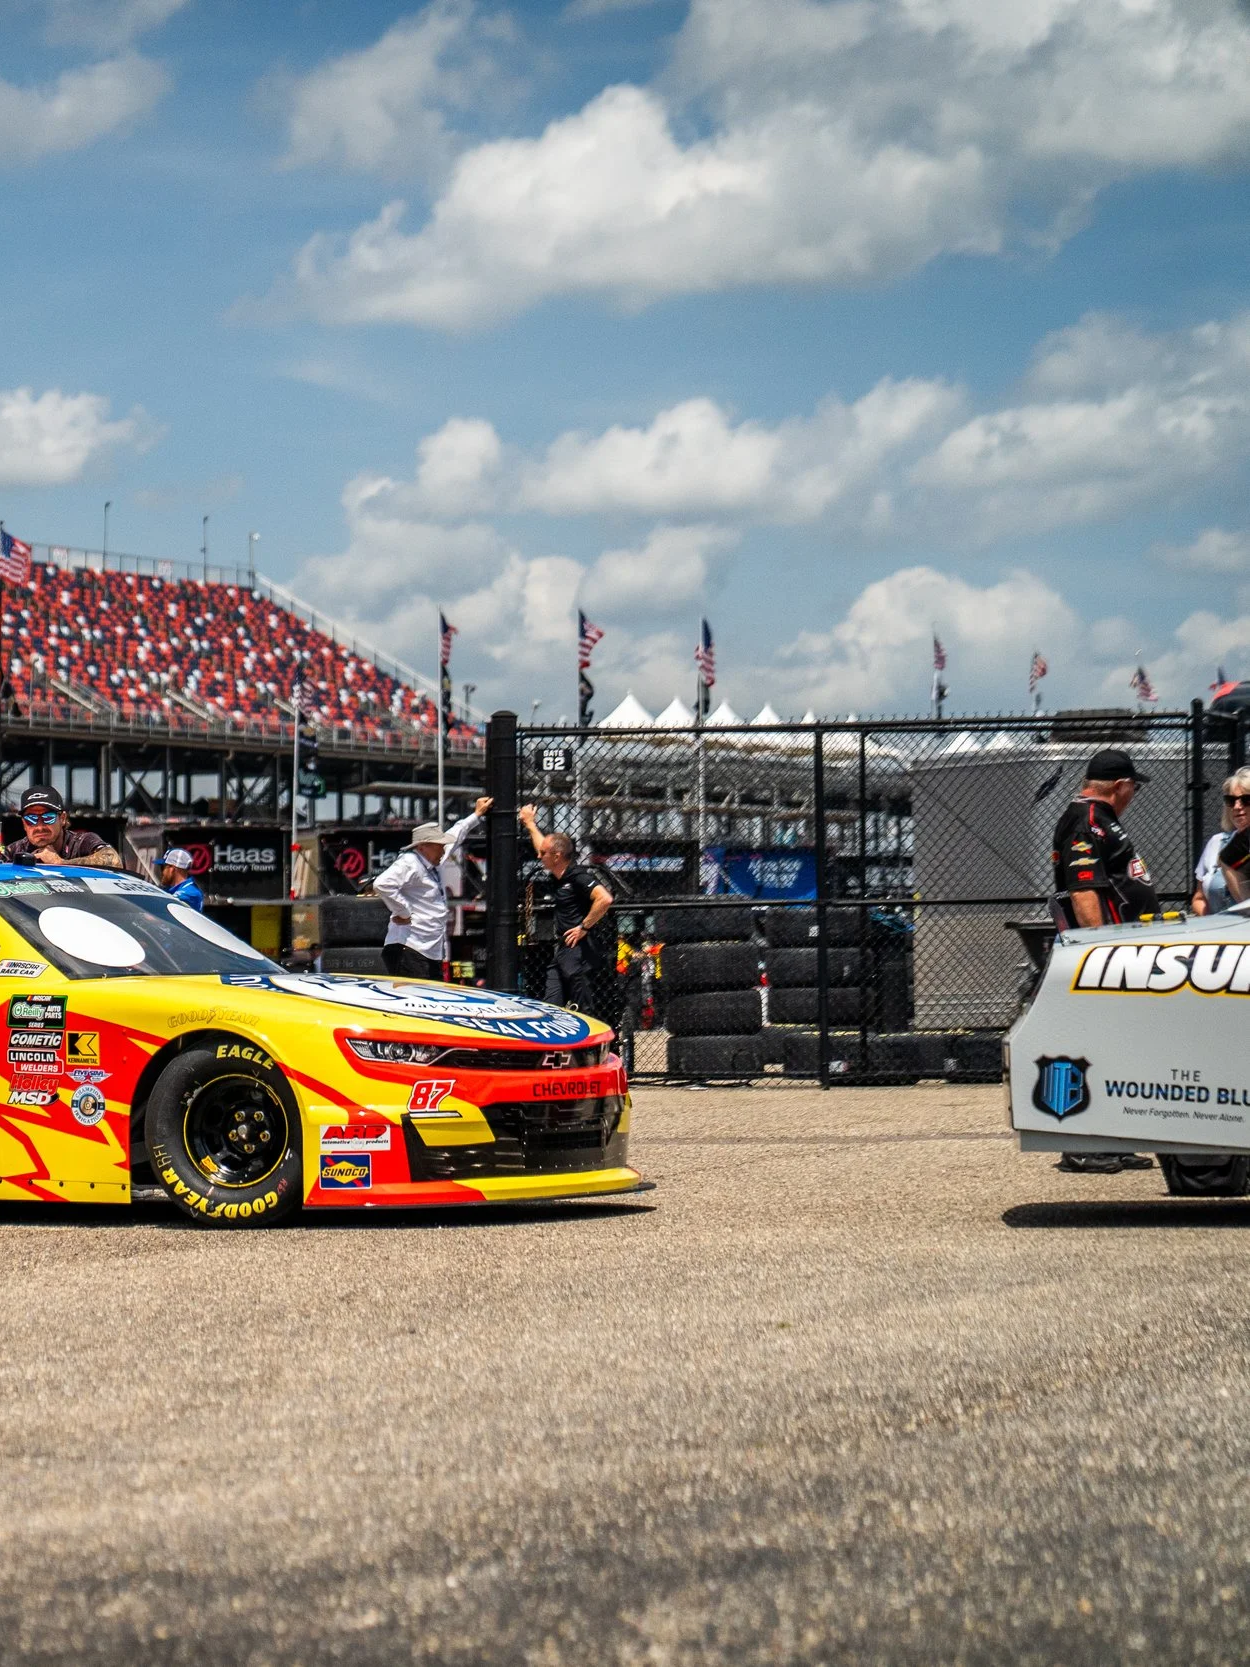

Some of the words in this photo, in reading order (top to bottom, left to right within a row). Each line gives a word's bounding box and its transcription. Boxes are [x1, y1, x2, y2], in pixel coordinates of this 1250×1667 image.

[542, 757, 566, 771] G2
[213, 845, 276, 863] Haas
[213, 864, 248, 873] Factory
[251, 863, 275, 872] Team
[12, 1001, 46, 1021] O'Reilly
[166, 1006, 261, 1029] GOODYEAR
[453, 1017, 539, 1038] SEAL
[10, 1032, 62, 1047] COMETIC
[10, 1052, 54, 1062] LINCOLN
[216, 1044, 275, 1071] EAGLE
[20, 1063, 59, 1073] WELDERS
[1171, 1068, 1202, 1082] THE
[10, 1074, 59, 1096] Holley
[532, 1080, 602, 1097] CHEVROLET
[1105, 1079, 1211, 1104] WOUNDED
[7, 1091, 54, 1106] MSD
[406, 1079, 457, 1112] 87
[1122, 1105, 1148, 1117] Never
[1192, 1110, 1218, 1121] Never
[321, 1125, 388, 1139] ARP
[323, 1167, 367, 1177] SUNOCO
[161, 1166, 279, 1220] GOODYEAR
